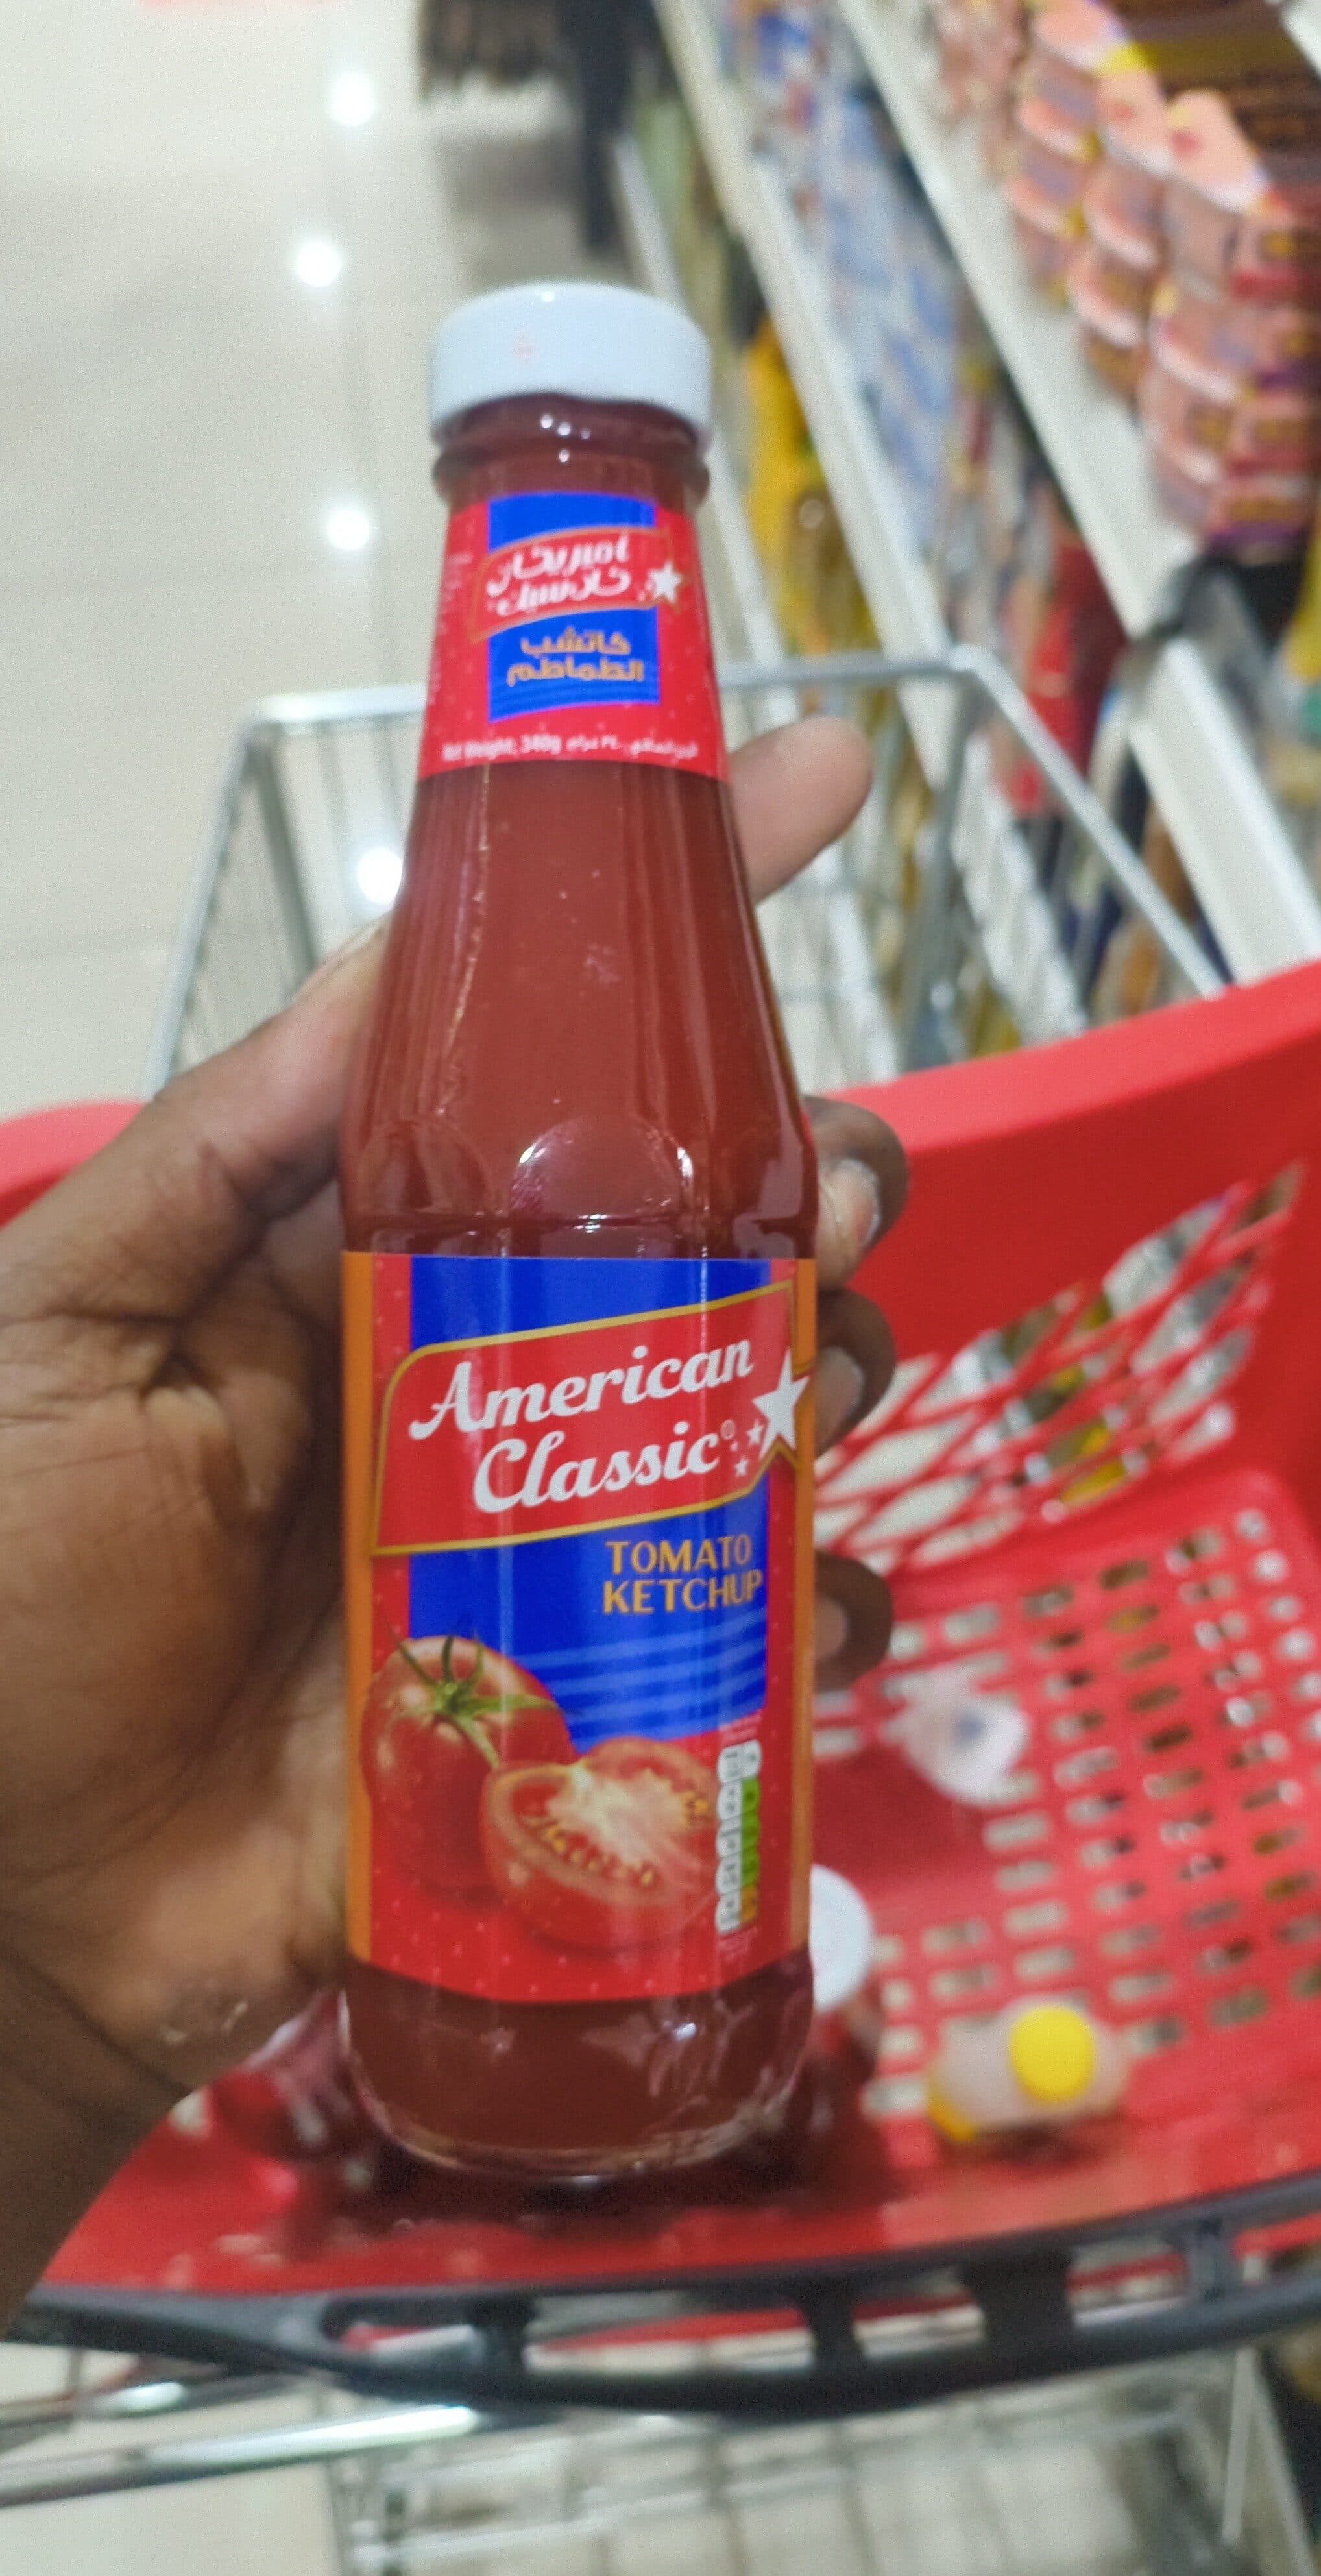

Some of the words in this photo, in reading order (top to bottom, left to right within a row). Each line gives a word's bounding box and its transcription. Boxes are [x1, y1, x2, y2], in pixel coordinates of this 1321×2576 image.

[521, 627, 631, 658] كاتشب
[507, 657, 644, 687] الطماطم
[521, 734, 562, 755] 340g
[409, 1340, 753, 1440] American
[605, 1534, 751, 1575] TOMATO
[603, 1568, 764, 1614] KETCHUP
